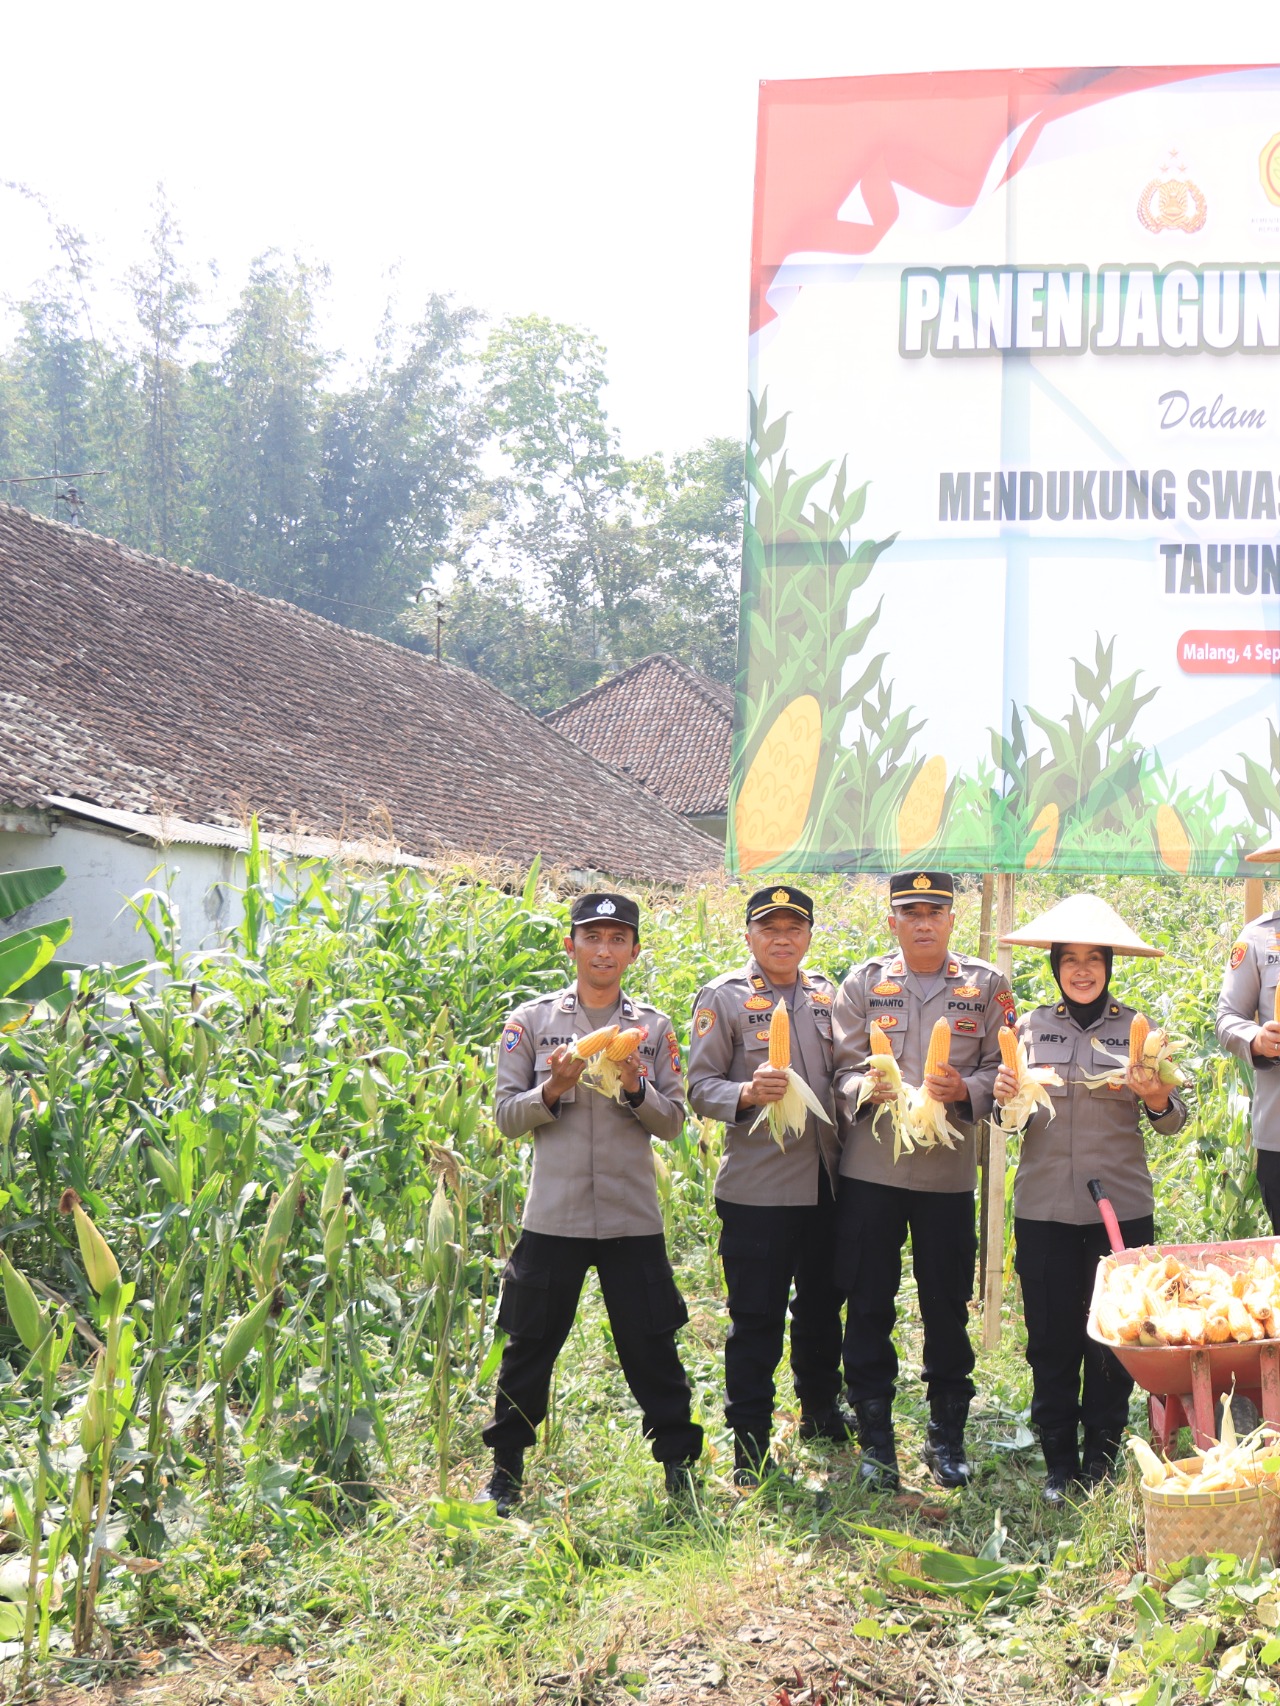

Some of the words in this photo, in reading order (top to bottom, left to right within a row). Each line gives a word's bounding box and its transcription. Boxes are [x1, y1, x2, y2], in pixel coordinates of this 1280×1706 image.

[902, 266, 1087, 355] PANEN
[1158, 390, 1267, 431] Dalam
[938, 469, 1177, 522] MENDUKUNG
[1183, 643, 1240, 664] Malang,
[1242, 645, 1252, 660] 4
[869, 999, 904, 1008] WINANTO
[948, 1002, 986, 1013] POLRI
[748, 1012, 772, 1024] EKO
[813, 1008, 832, 1018] POL
[1039, 1033, 1068, 1044] MEY
[1099, 1038, 1130, 1047] POLR
